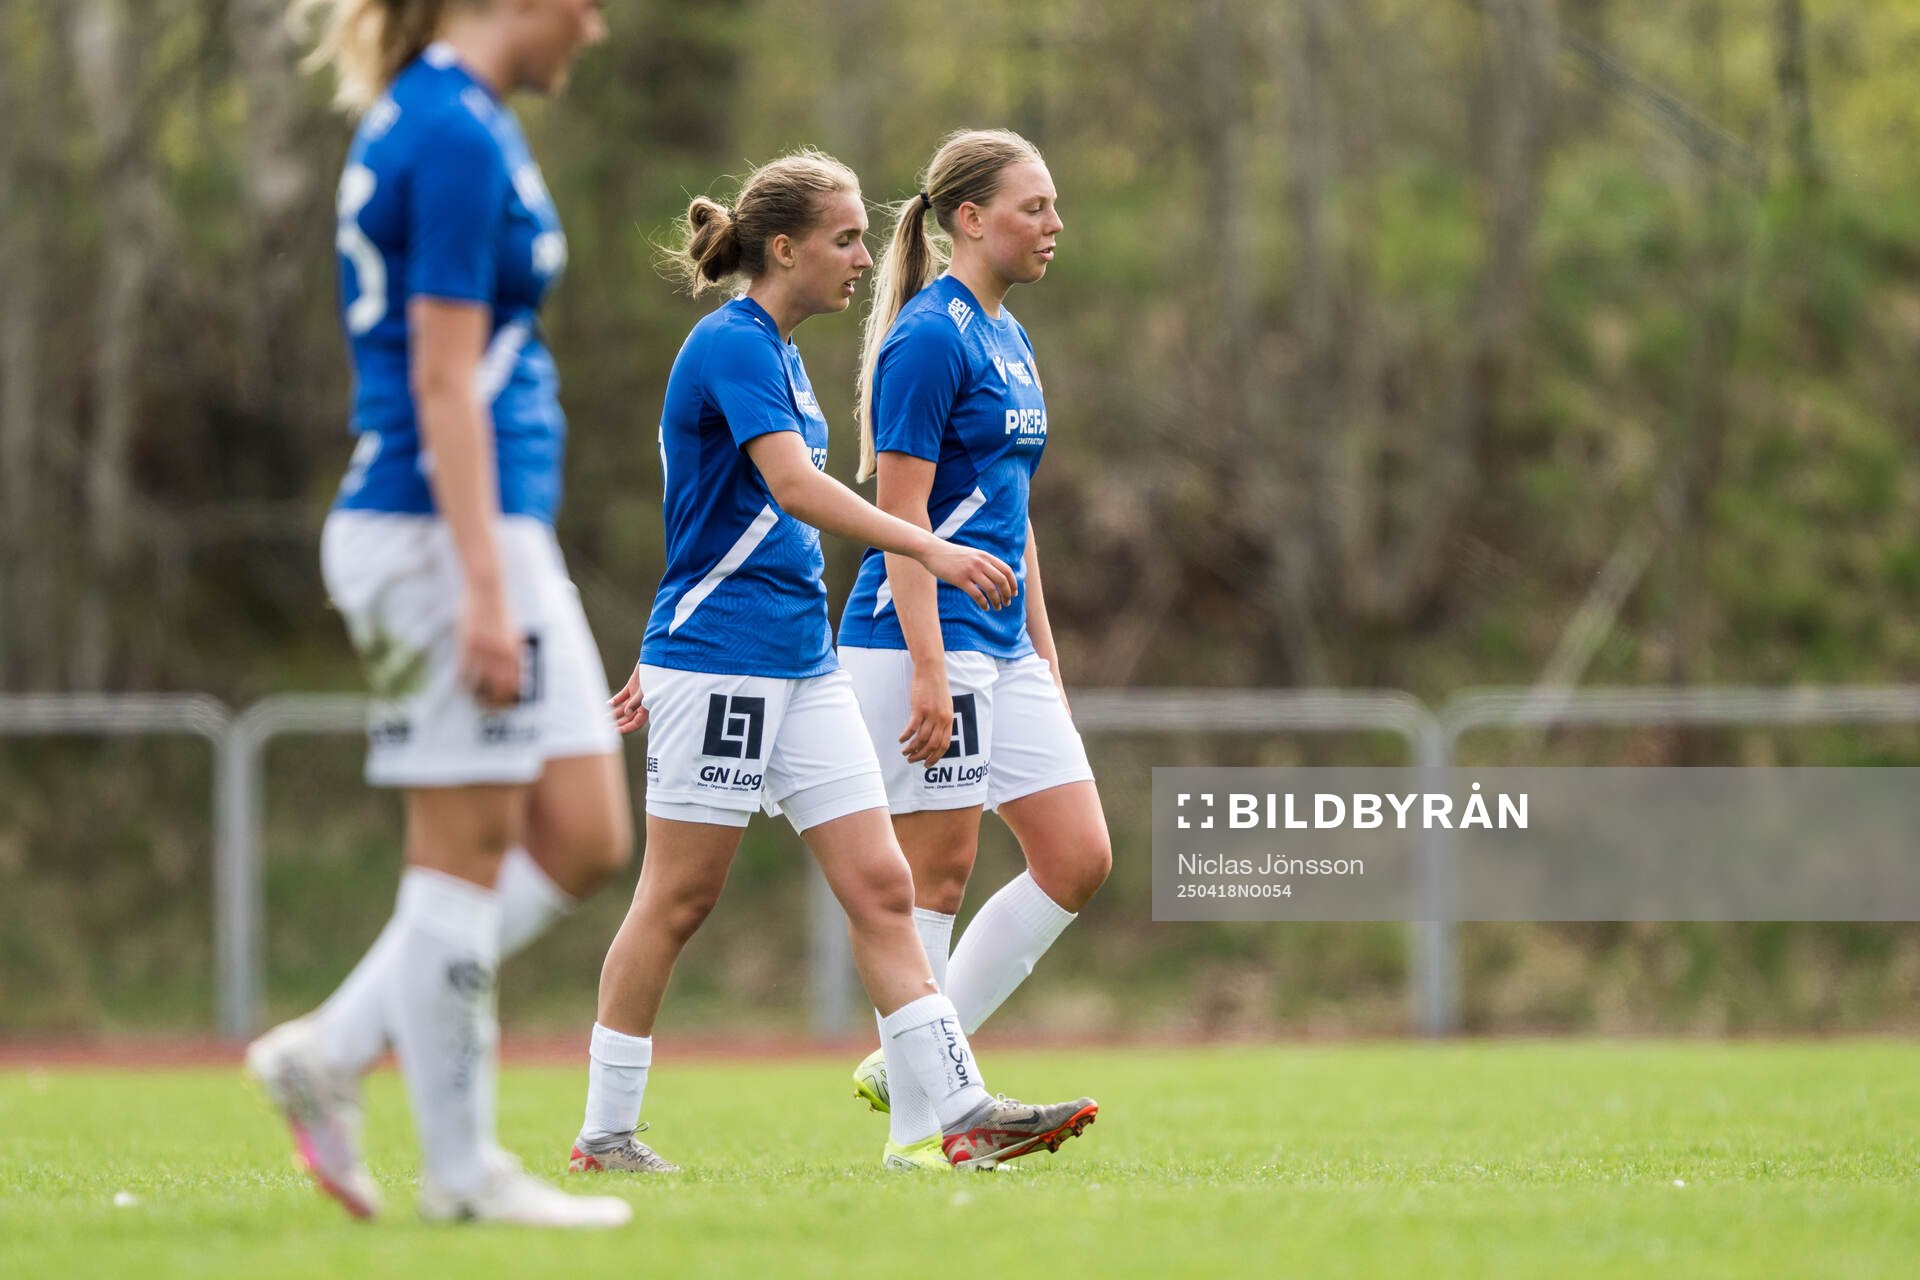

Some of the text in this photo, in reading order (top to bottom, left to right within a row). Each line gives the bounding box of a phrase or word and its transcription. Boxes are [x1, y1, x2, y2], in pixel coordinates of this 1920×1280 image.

[700, 765, 731, 784] GN
[733, 769, 765, 792] Log
[924, 766, 953, 783] GN
[940, 1018, 969, 1088] LinSon
